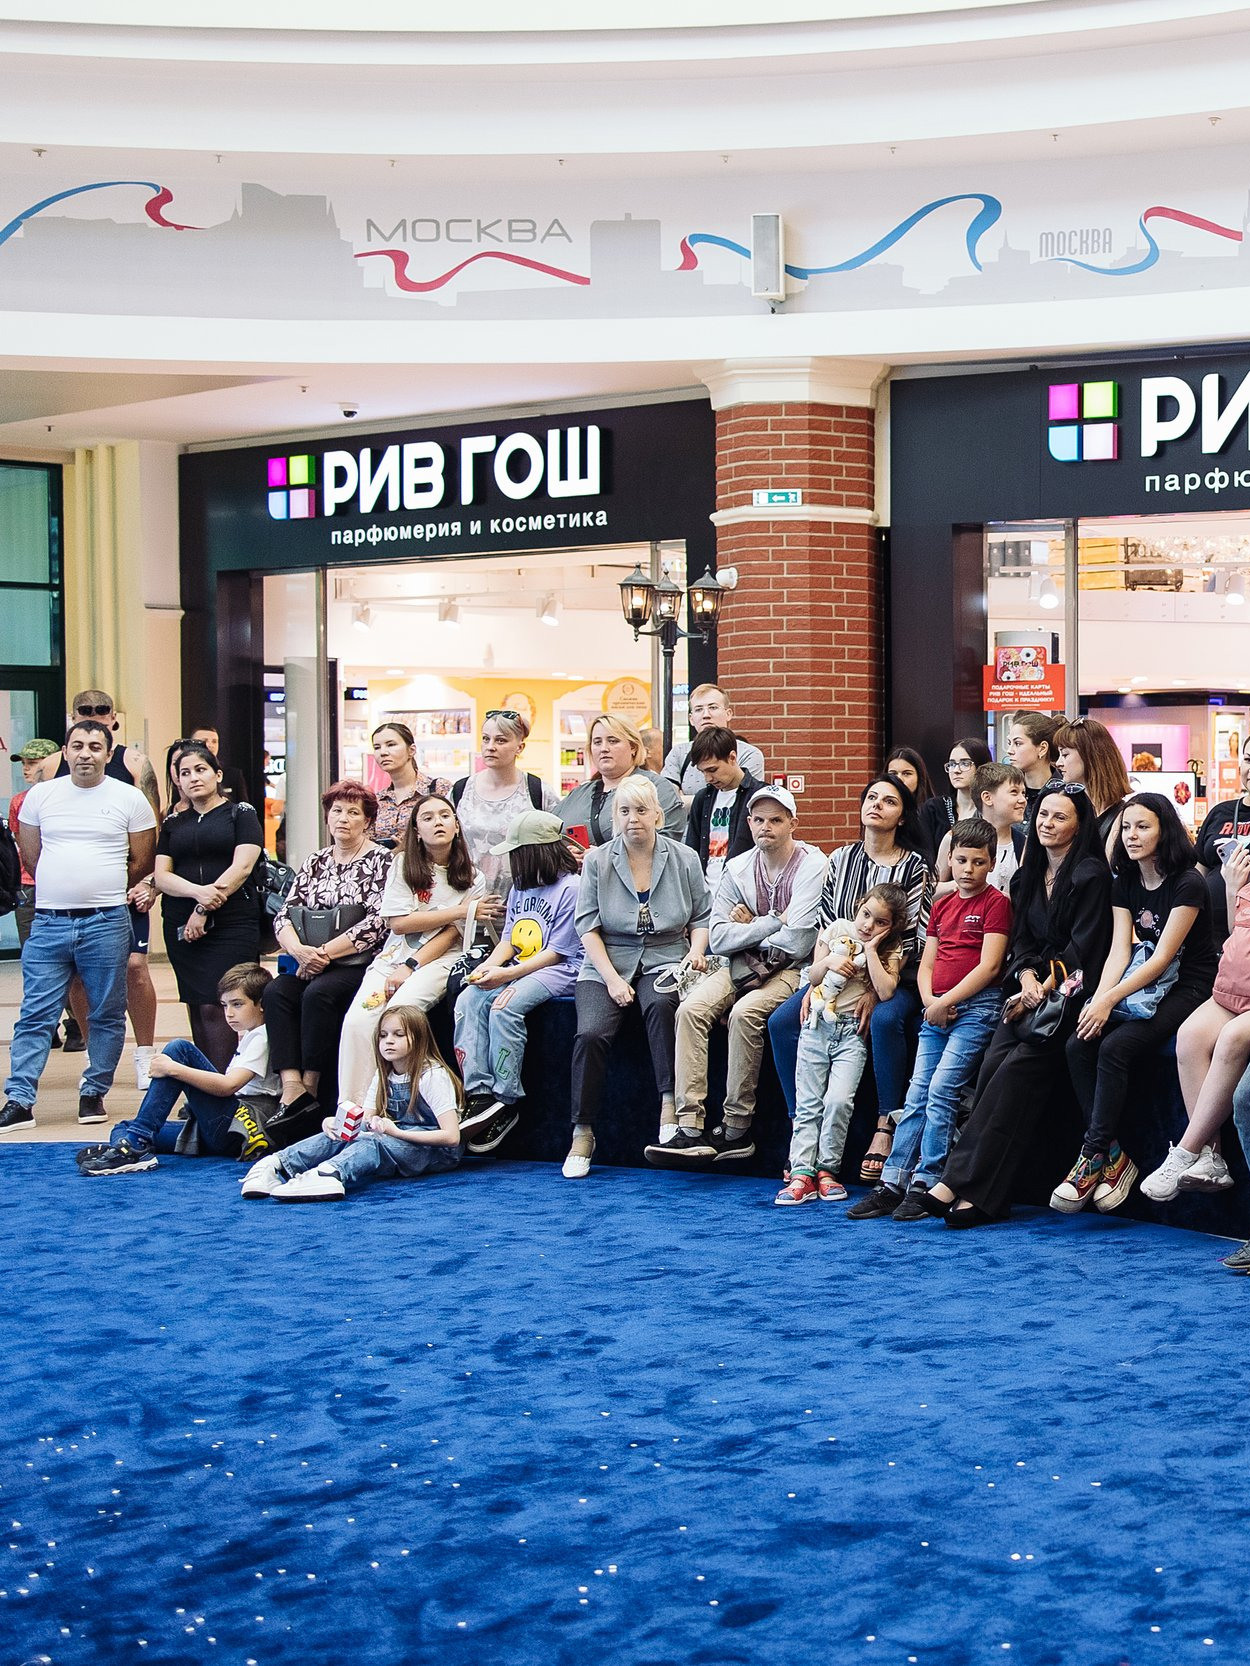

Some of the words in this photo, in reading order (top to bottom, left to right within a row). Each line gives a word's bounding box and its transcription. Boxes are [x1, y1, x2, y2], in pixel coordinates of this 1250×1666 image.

[365, 218, 573, 244] МОСКВА
[1038, 226, 1114, 259] МОСКВА
[322, 442, 446, 516] РИВ
[461, 425, 602, 506] ГОШ
[330, 519, 462, 547] парфюмерия
[469, 517, 482, 534] и
[489, 508, 608, 533] косметика
[523, 896, 555, 928] ORIGINA
